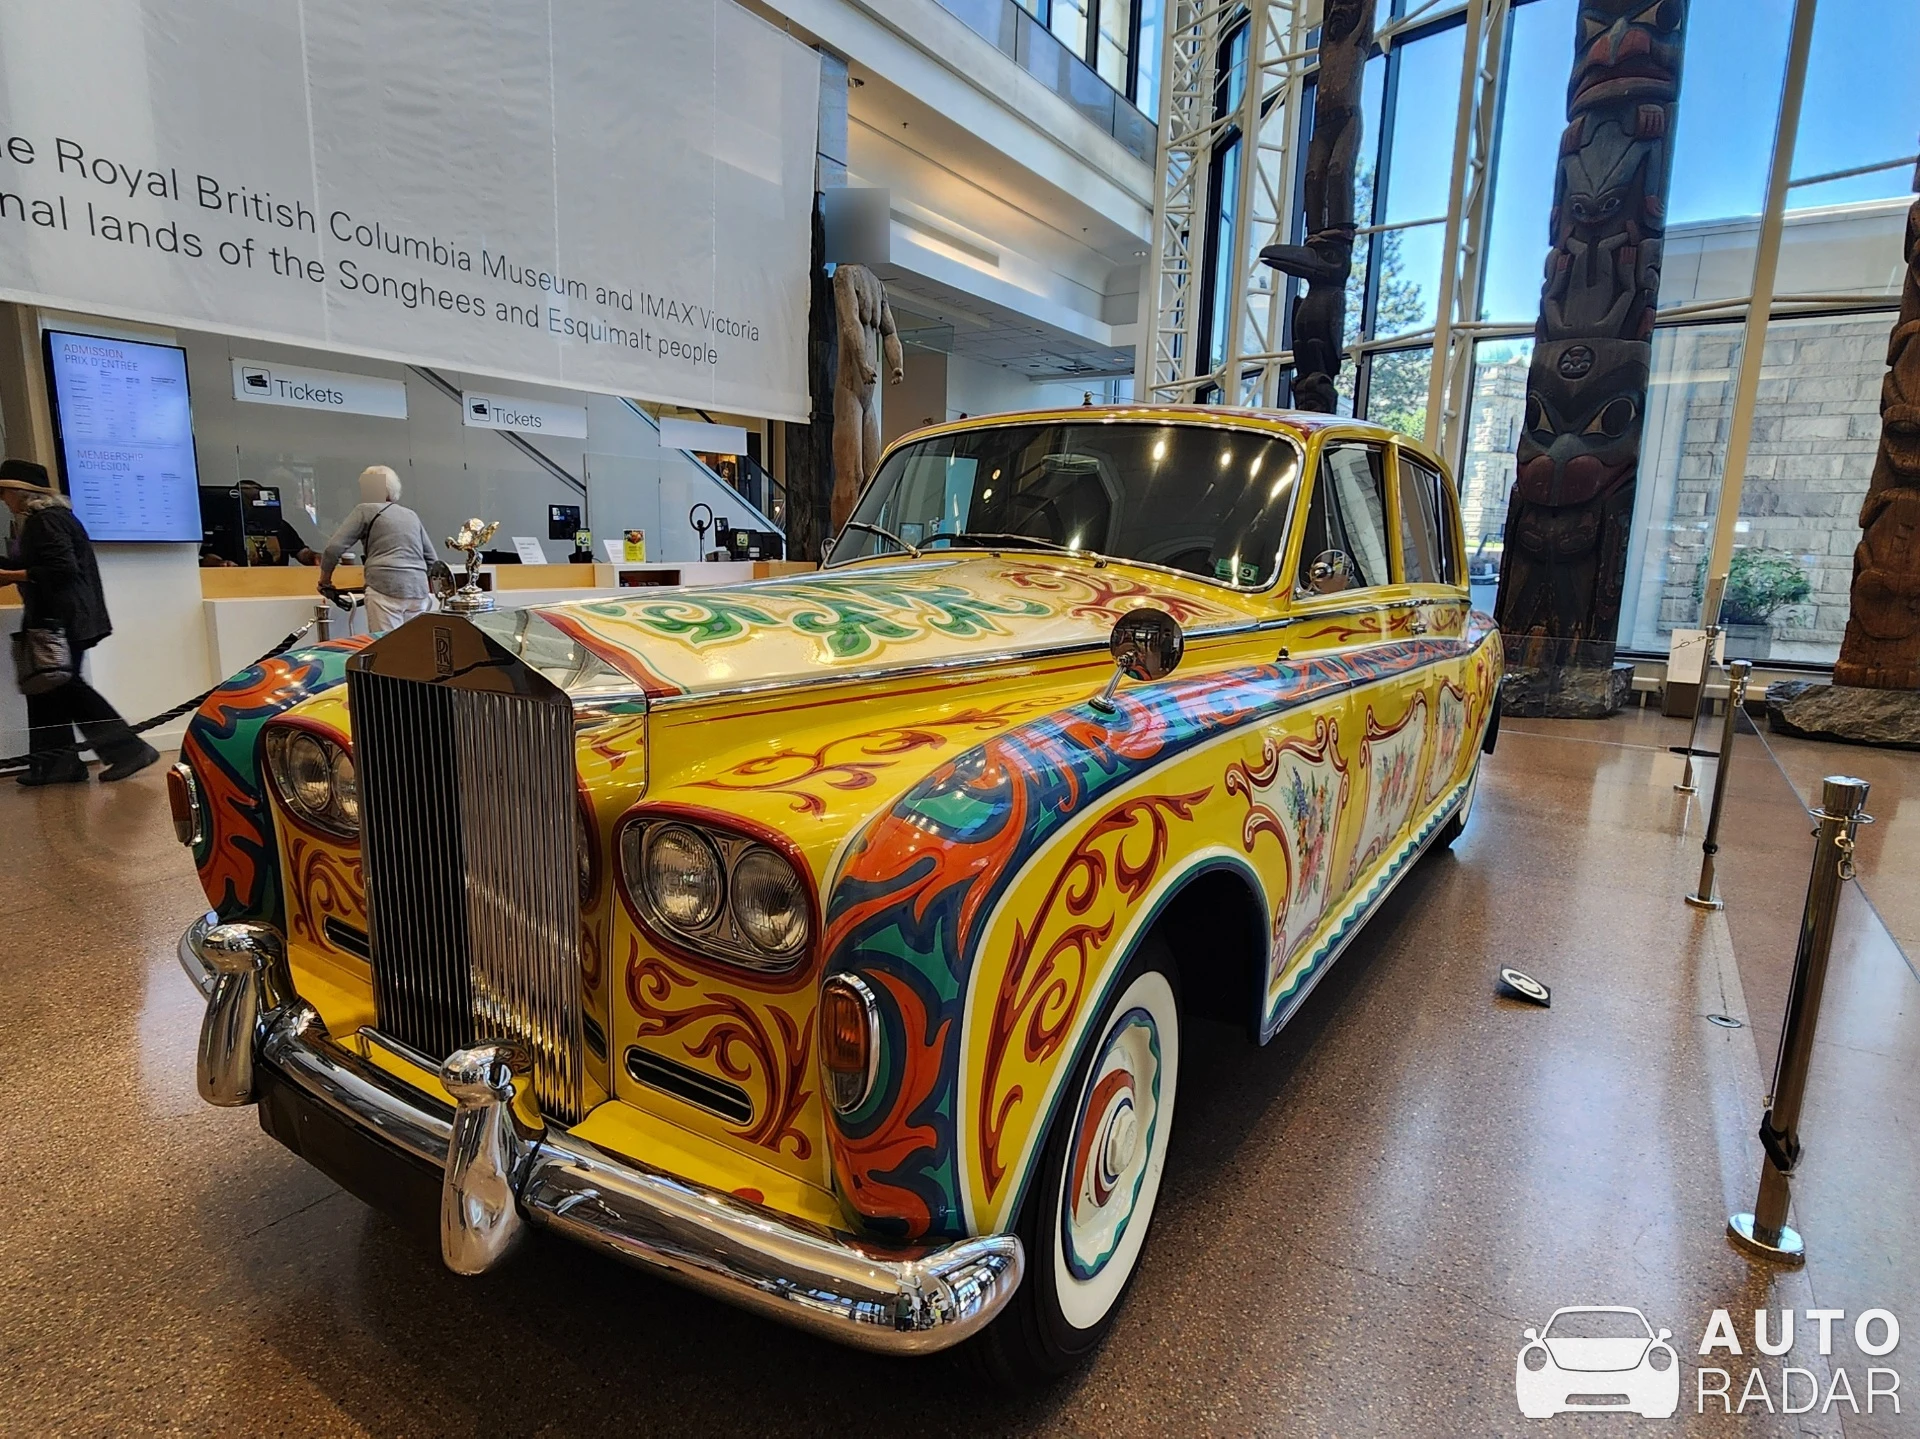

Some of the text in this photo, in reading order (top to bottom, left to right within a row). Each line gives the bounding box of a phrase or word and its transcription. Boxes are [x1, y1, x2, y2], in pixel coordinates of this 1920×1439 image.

[0, 136, 35, 165] e
[56, 138, 179, 200] Royal
[197, 174, 315, 233] British
[330, 211, 471, 271] Columbia
[482, 249, 587, 301] Museum
[595, 285, 632, 312] and
[699, 307, 760, 342] Victoria
[87, 202, 203, 258] lands
[219, 238, 254, 268] of
[269, 247, 325, 283] the
[339, 260, 486, 317] Songhees
[495, 300, 539, 328] and
[548, 307, 652, 352] Esquimalt
[658, 338, 718, 365] people
[63, 343, 123, 359] ADMISSION
[65, 354, 88, 366] PRIX
[275, 379, 344, 405] Tickets
[492, 407, 542, 428] Tickets
[77, 450, 144, 462] MEMBERSHIP
